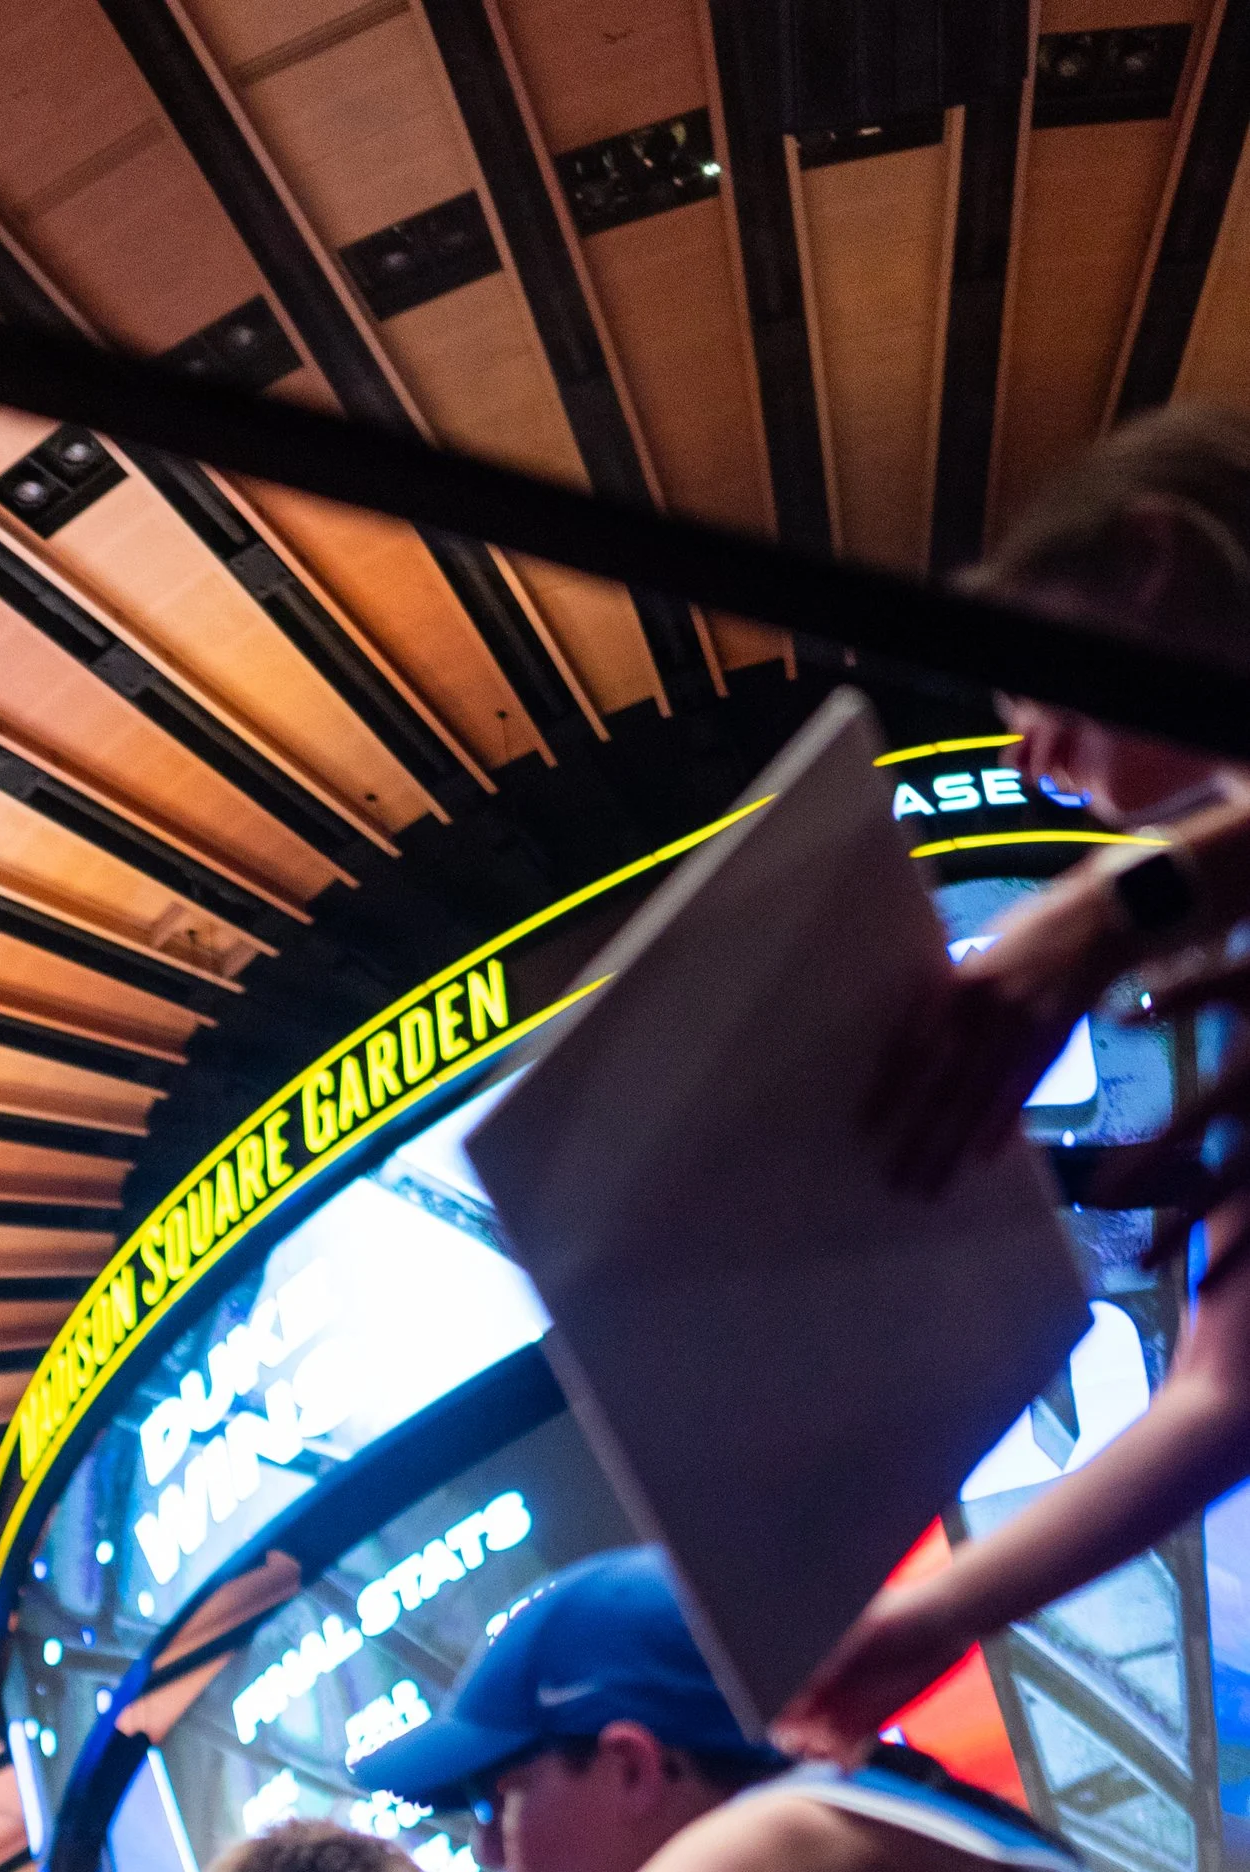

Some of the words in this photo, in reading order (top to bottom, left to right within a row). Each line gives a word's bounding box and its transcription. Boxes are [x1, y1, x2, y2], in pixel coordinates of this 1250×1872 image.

[140, 1109, 294, 1306] SQUARE
[301, 959, 509, 1153] GARDEN
[355, 1490, 532, 1638] STATS
